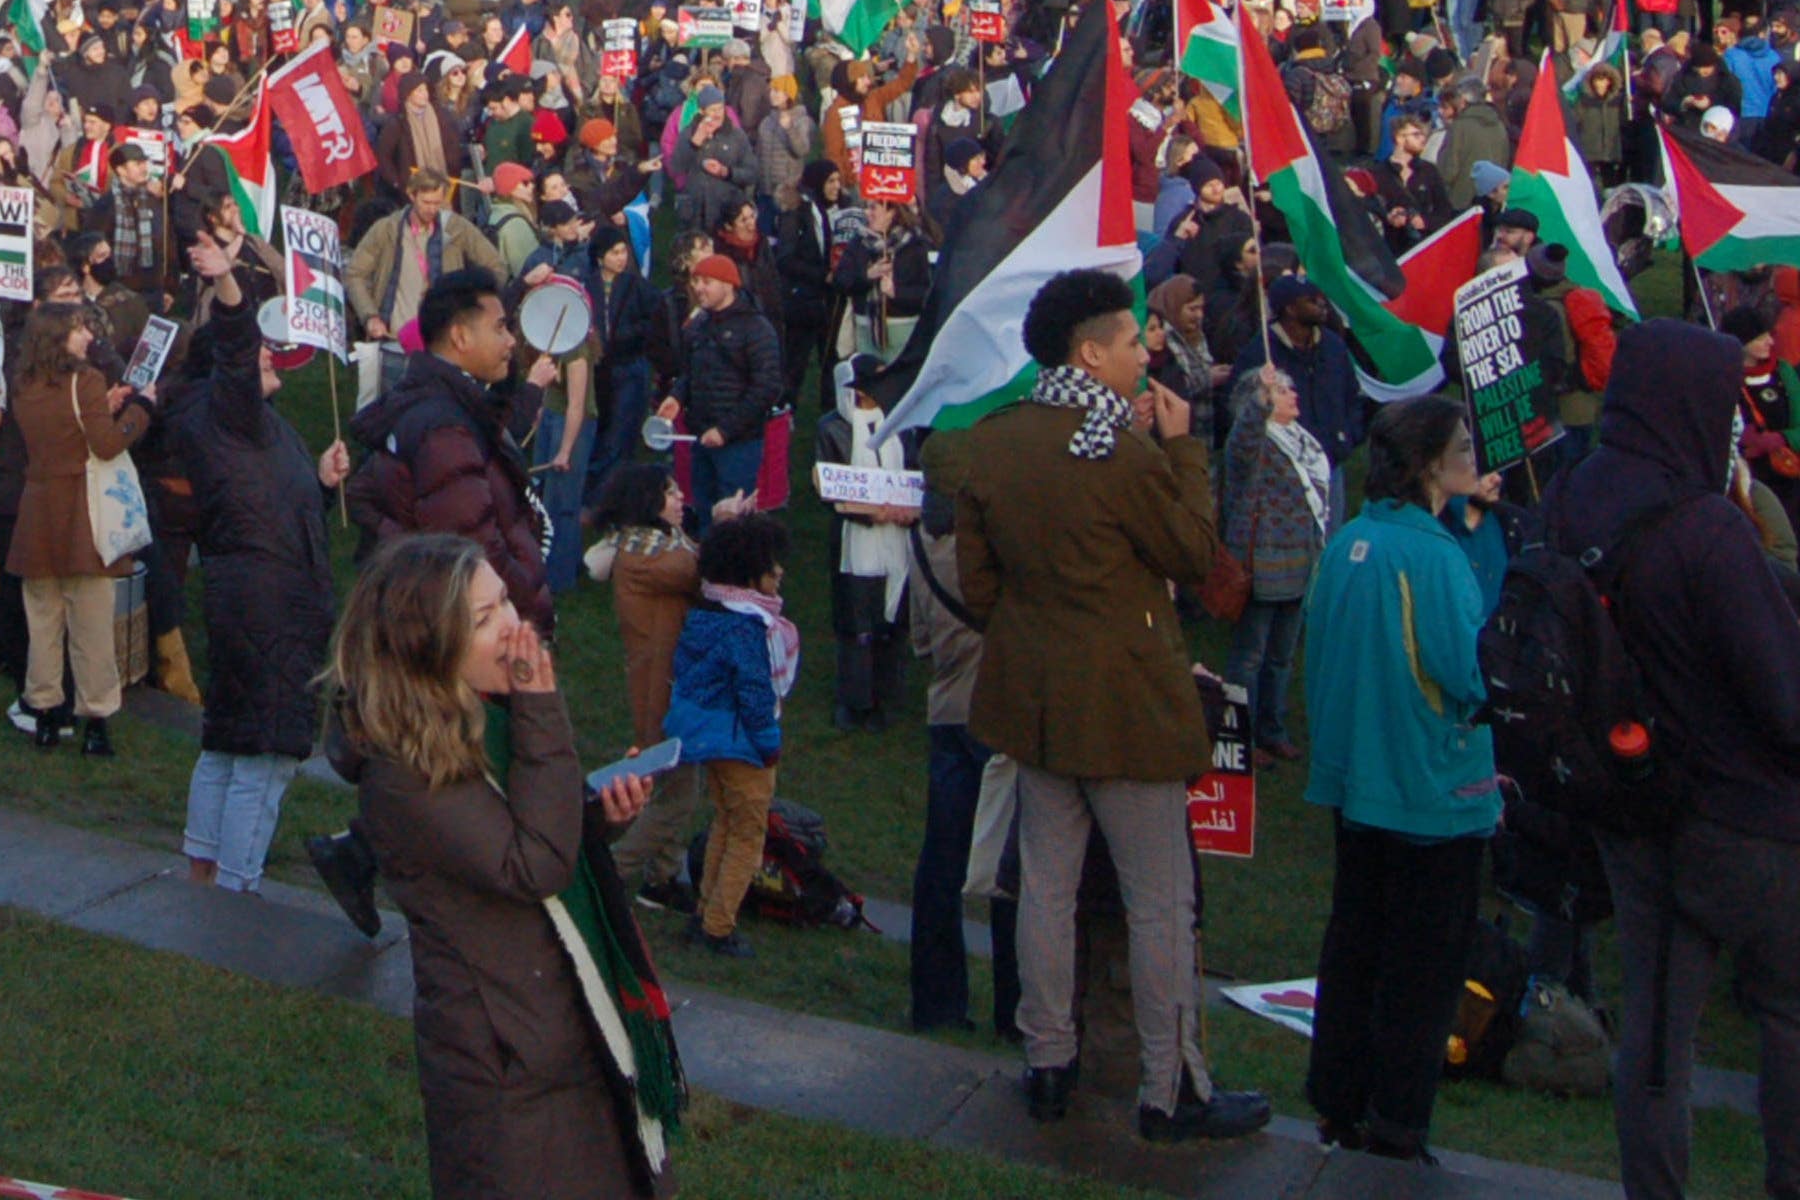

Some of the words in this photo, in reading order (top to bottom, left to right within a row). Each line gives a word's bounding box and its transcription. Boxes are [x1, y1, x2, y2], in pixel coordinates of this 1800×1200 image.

[3, 263, 26, 276] THE
[1459, 298, 1495, 338] FROM
[1492, 285, 1523, 317] THE
[1462, 325, 1502, 364] RIVER
[1498, 314, 1522, 343] TO
[1466, 356, 1498, 390] THE
[1495, 342, 1523, 375] SEA
[1473, 360, 1543, 415] PALESTINE
[1479, 406, 1518, 441] WILL
[1515, 393, 1536, 422] BE
[1485, 429, 1524, 467] FREE
